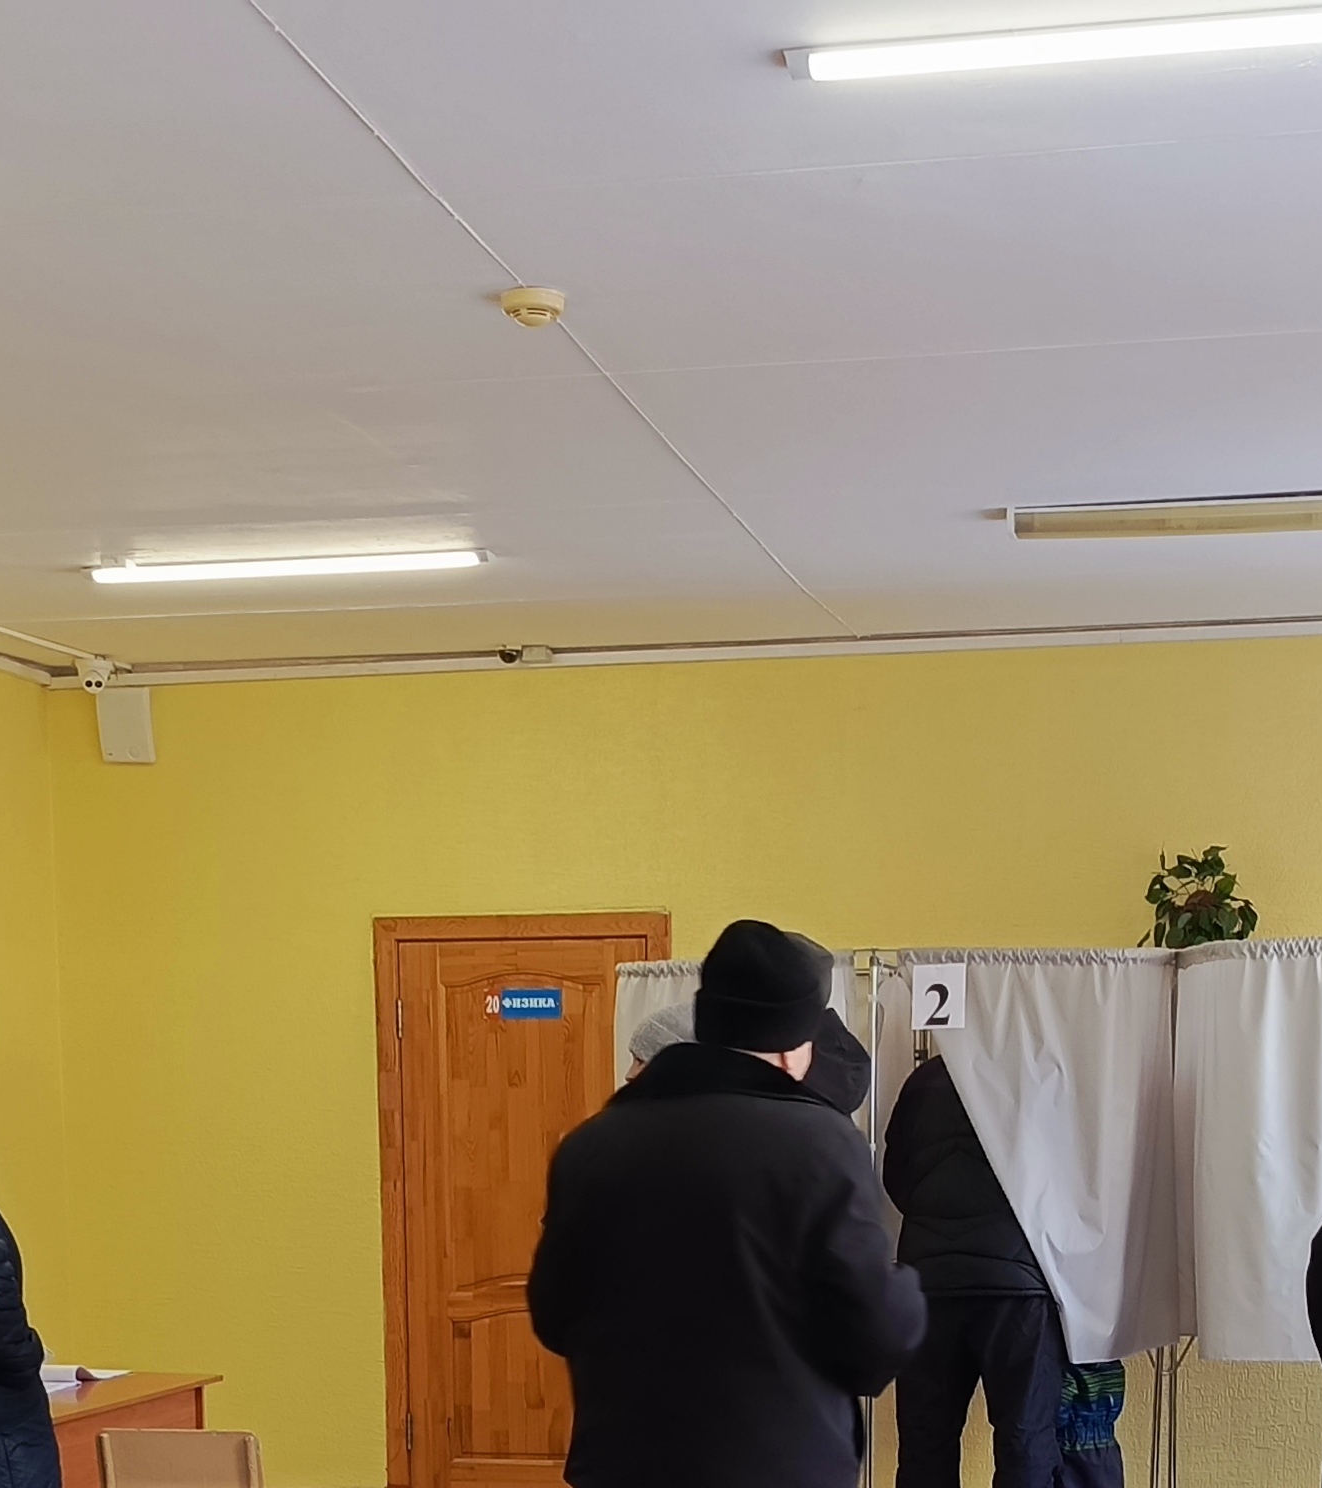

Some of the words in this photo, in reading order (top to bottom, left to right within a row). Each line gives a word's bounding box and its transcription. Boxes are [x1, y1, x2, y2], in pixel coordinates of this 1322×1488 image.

[485, 995, 500, 1014] 20
[502, 997, 556, 1009] ФИЗИКА
[924, 983, 950, 1026] 2
